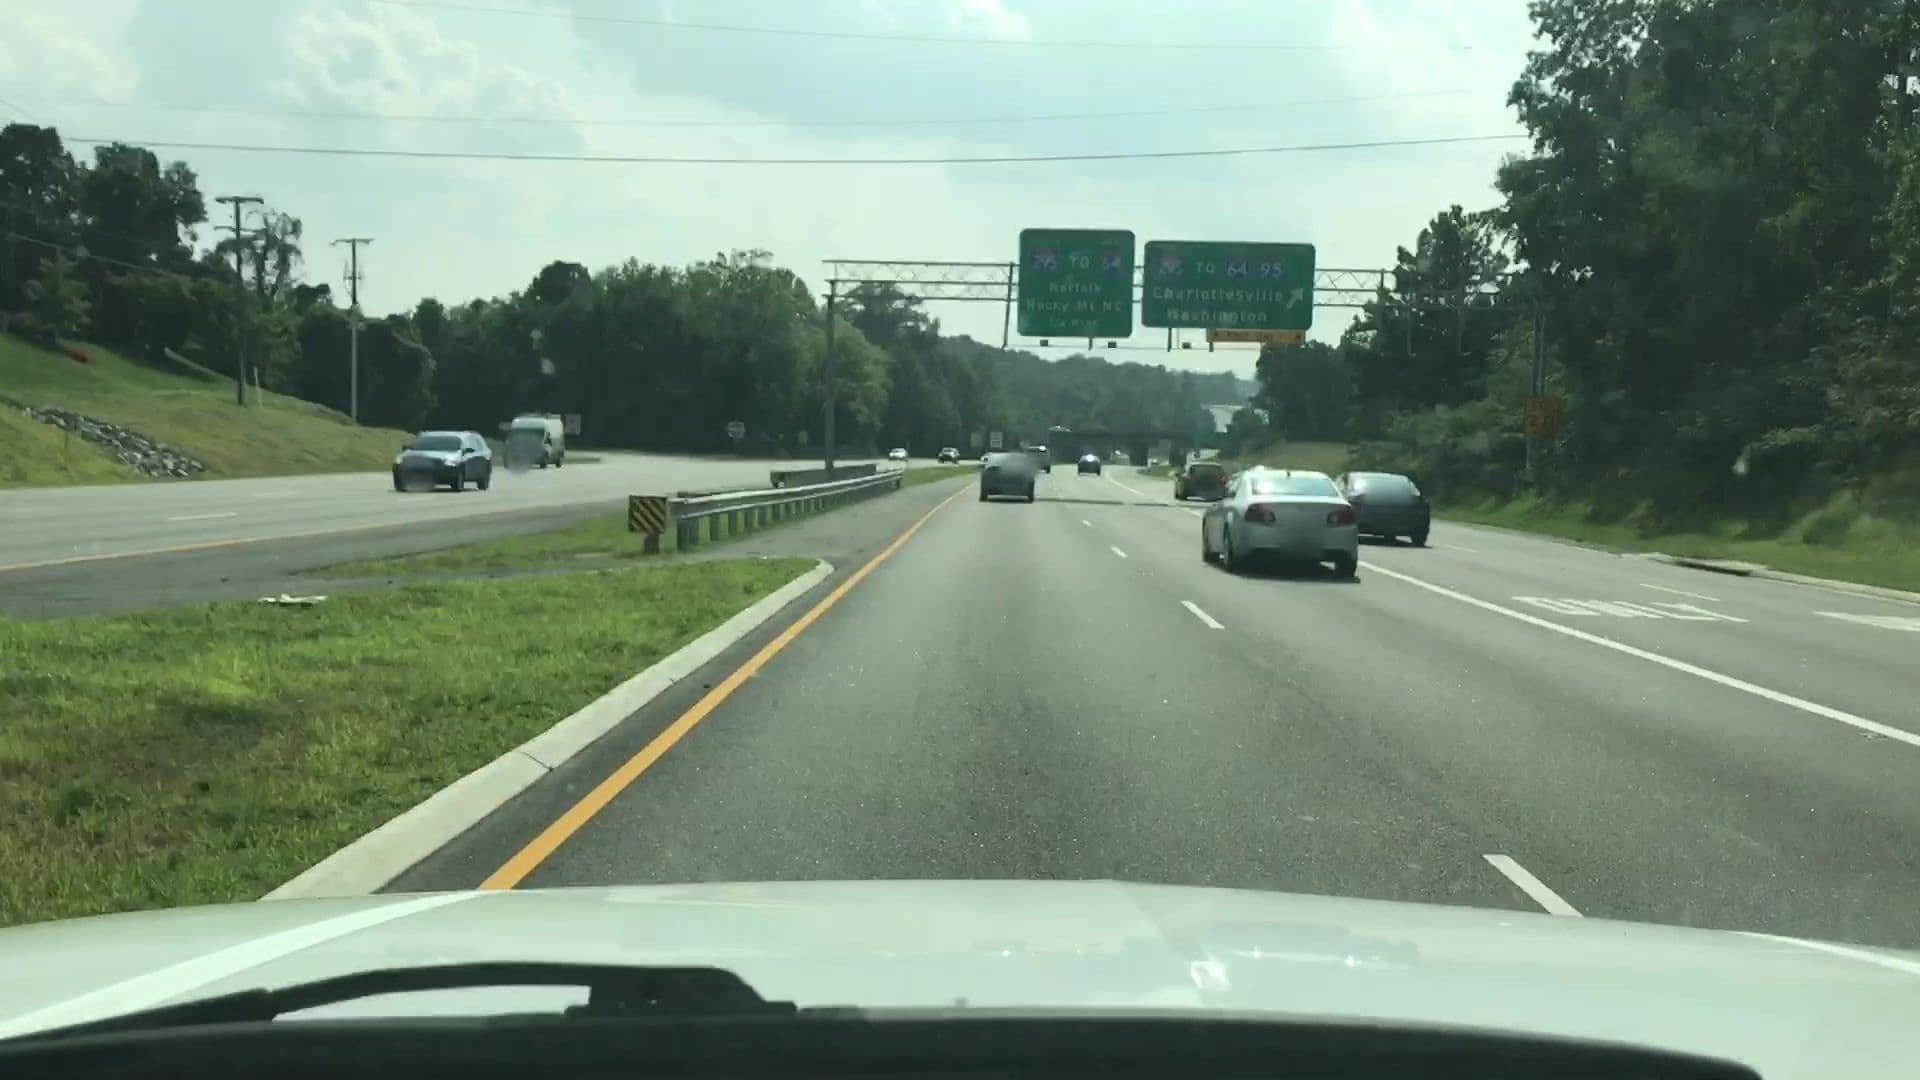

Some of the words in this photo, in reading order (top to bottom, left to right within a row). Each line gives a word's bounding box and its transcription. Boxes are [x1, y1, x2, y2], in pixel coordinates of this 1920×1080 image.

[1069, 255, 1090, 270] TO
[1196, 261, 1215, 274] TO
[1226, 262, 1249, 276] 64
[1260, 263, 1282, 278] 95
[1152, 287, 1283, 302] Charlottesville
[1167, 308, 1267, 323] Washington
